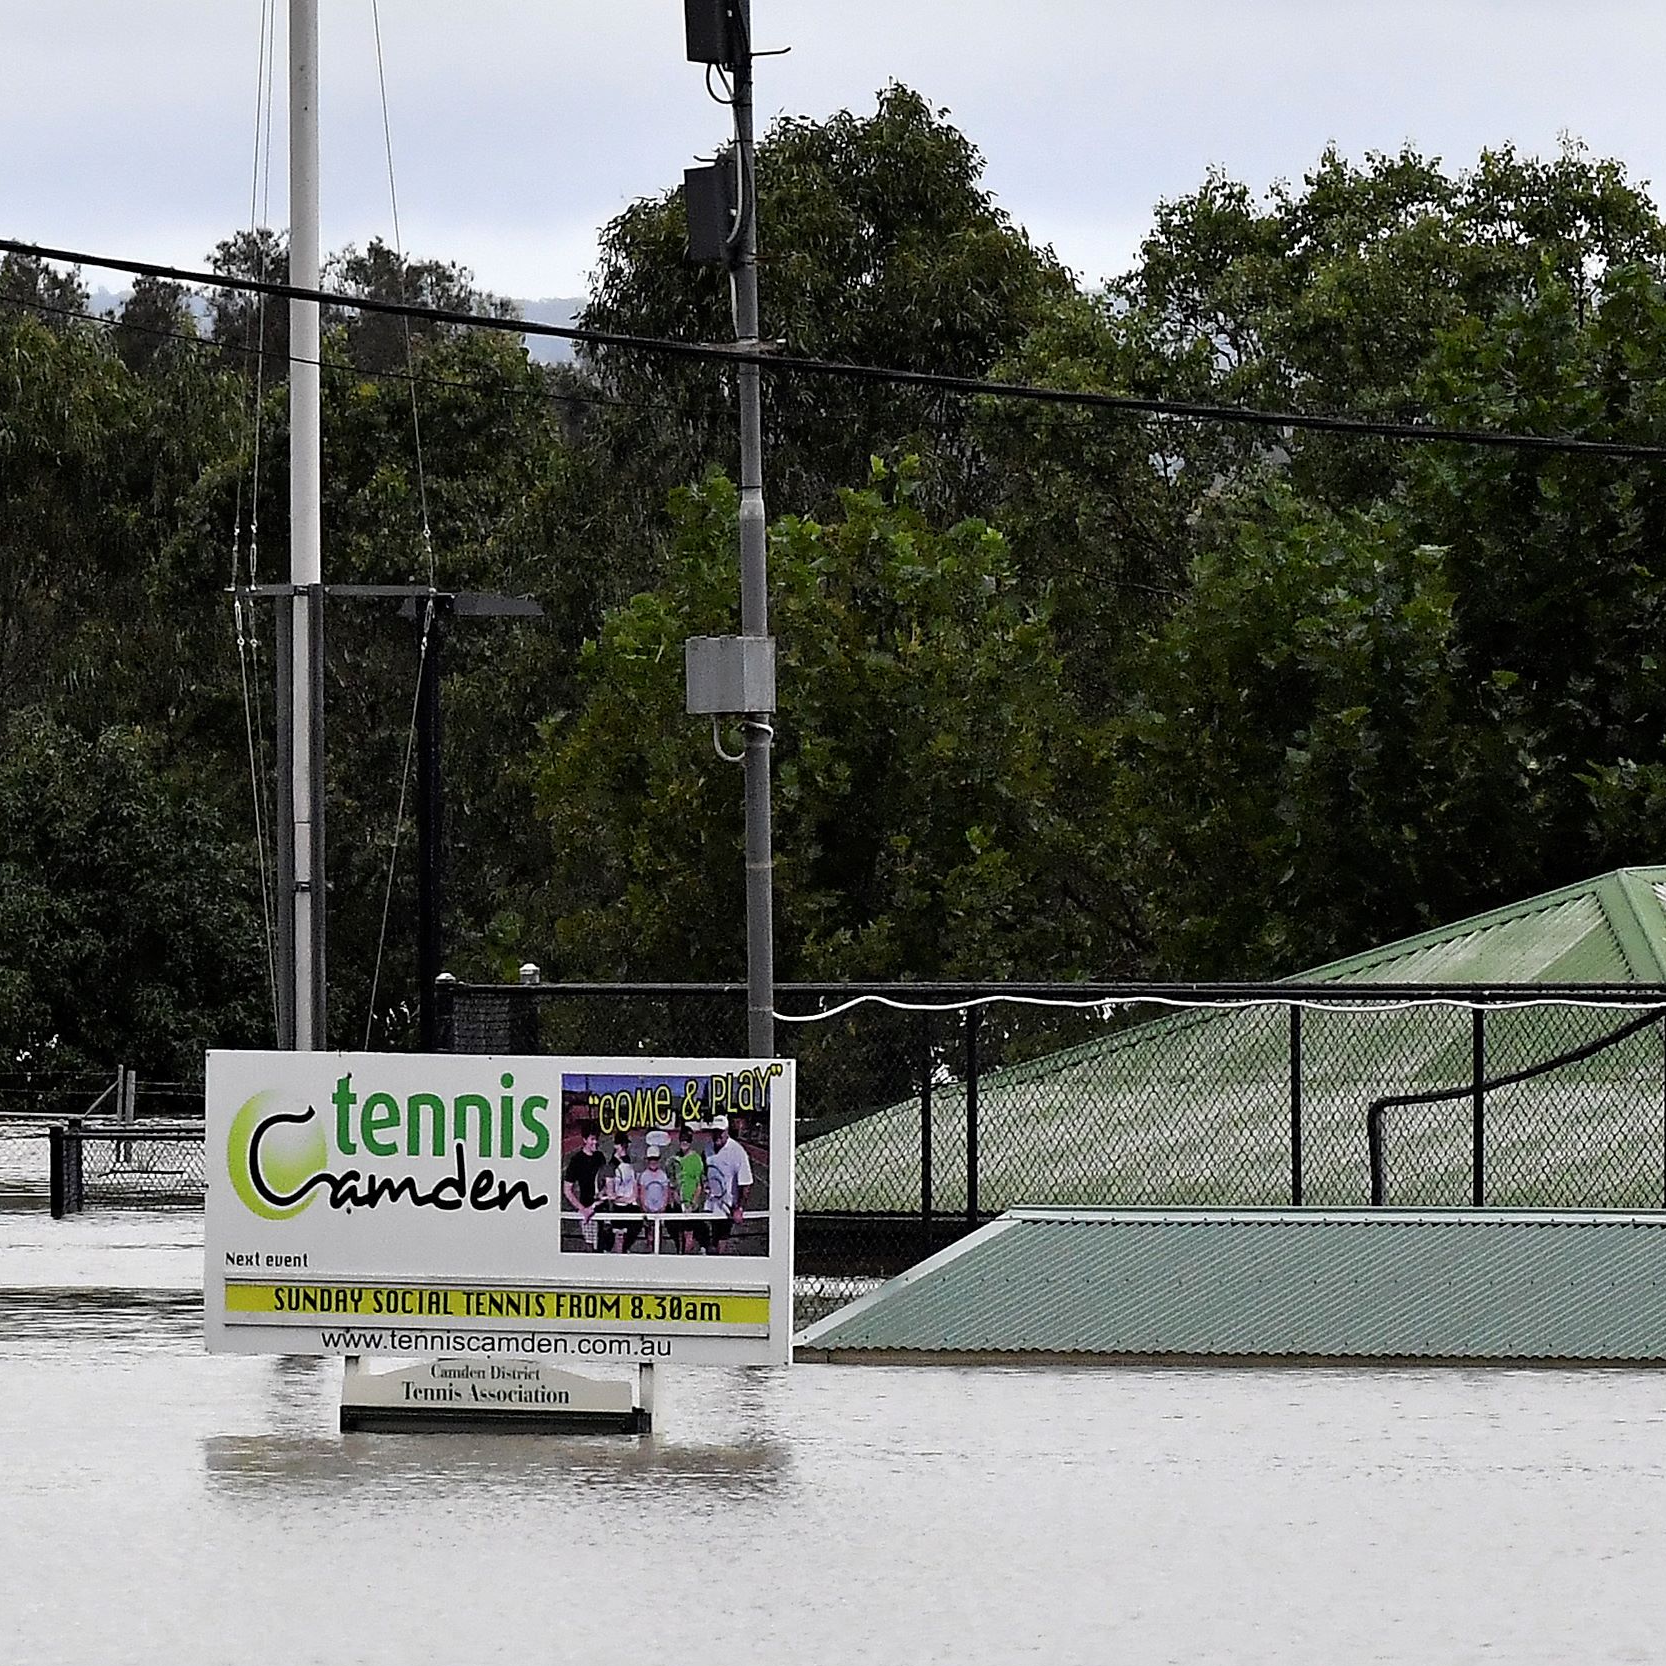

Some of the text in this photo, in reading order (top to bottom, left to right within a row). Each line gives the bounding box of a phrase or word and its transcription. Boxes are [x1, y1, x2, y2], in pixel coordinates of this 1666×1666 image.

[682, 1079, 701, 1120] &
[332, 1073, 549, 1159] tennis
[248, 1105, 549, 1211] Camden
[225, 1252, 309, 1268] Next event
[274, 1287, 722, 1321] SUNDAY SOCIAL TENNIS FROM 8.30am
[321, 1329, 673, 1357] www.tenniscamden.com.au
[430, 1364, 541, 1382] Camden District
[402, 1381, 571, 1405] Tennis Association
